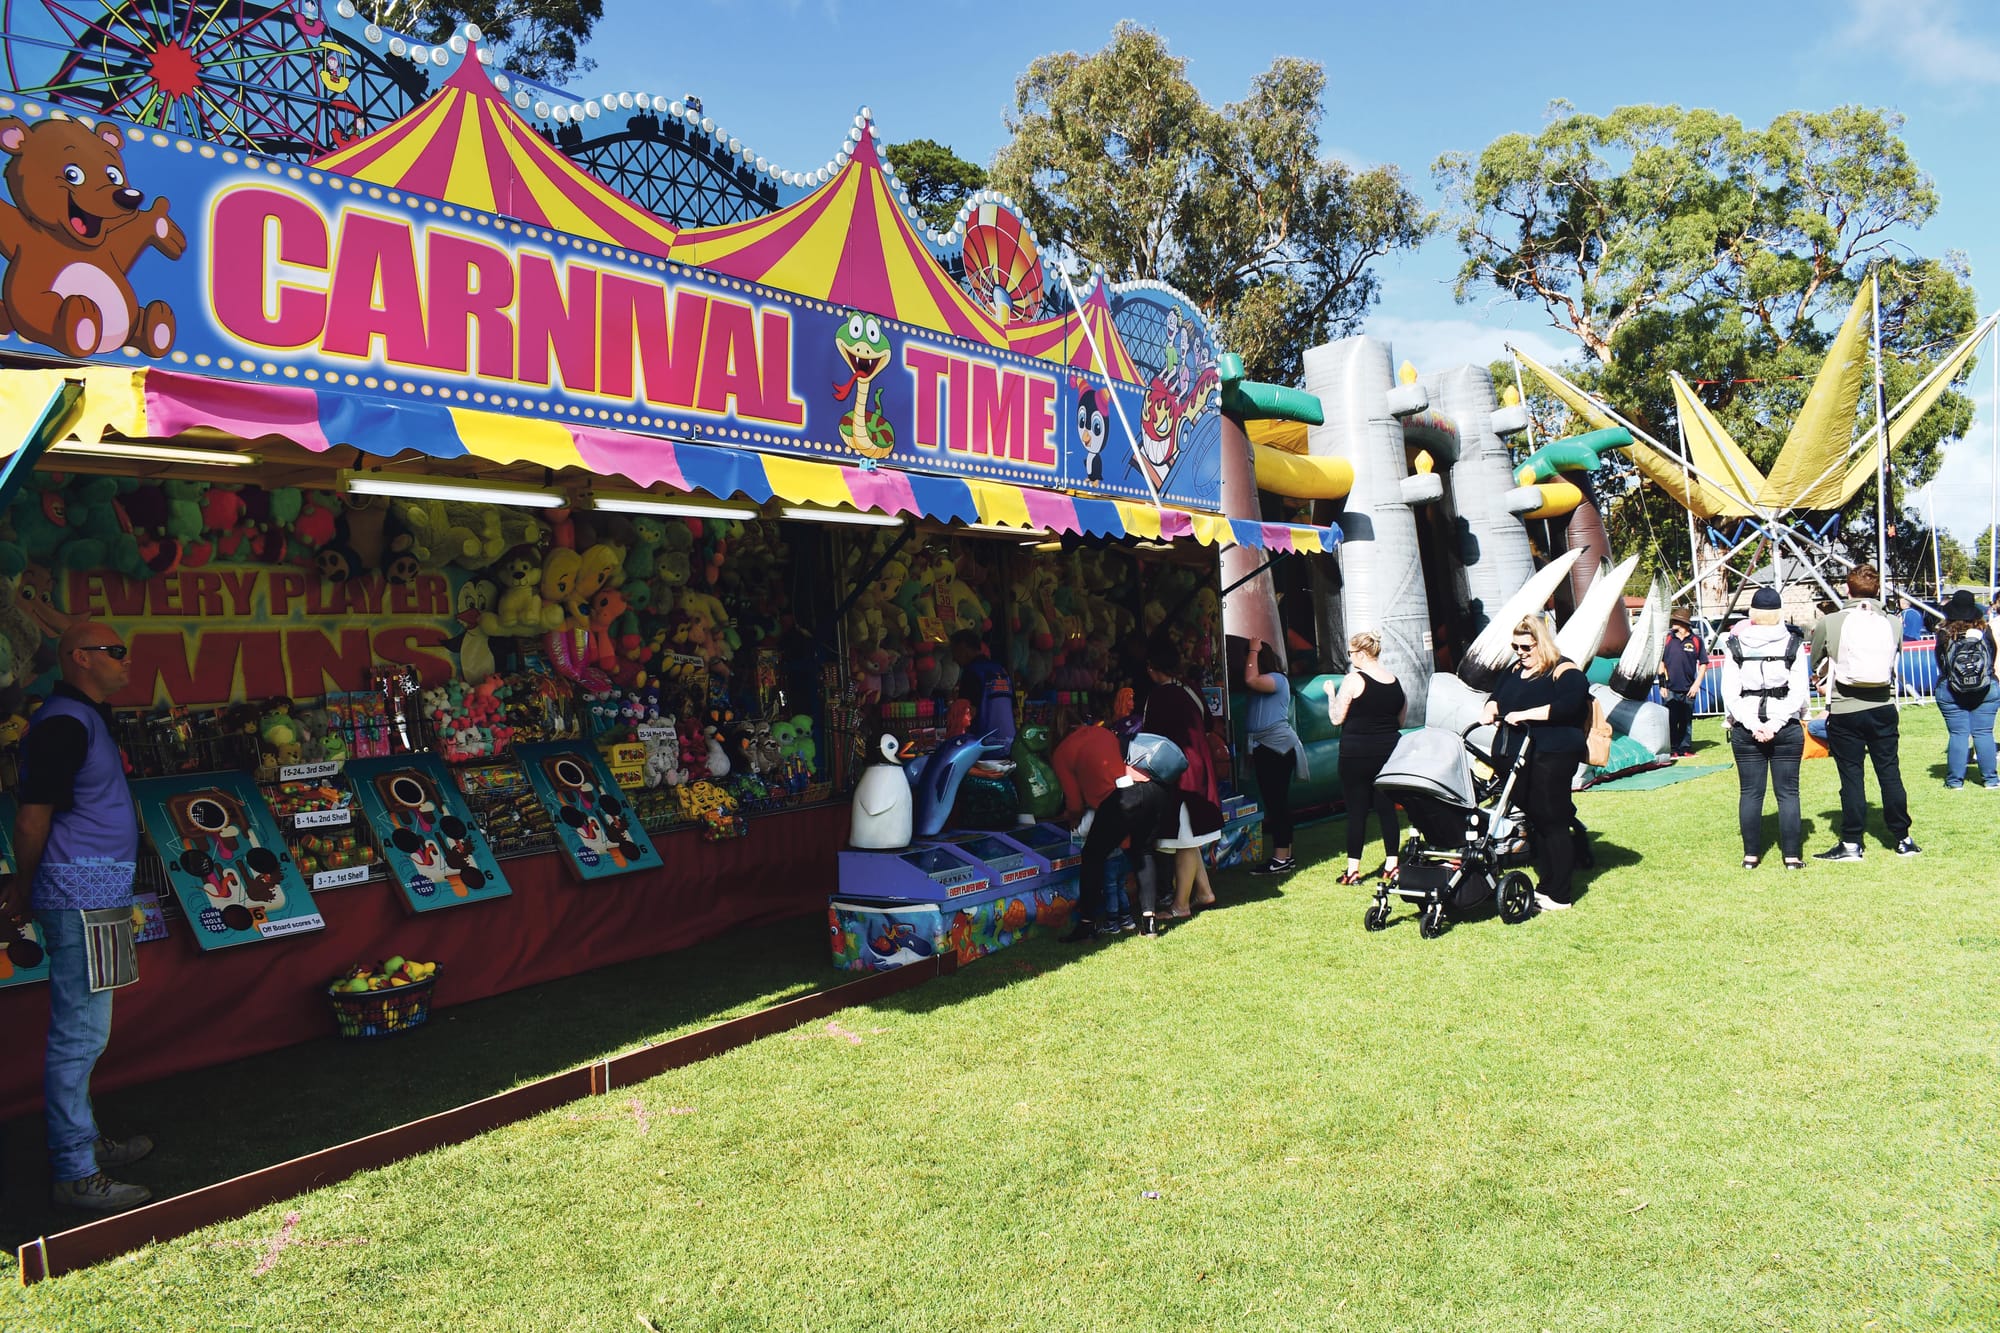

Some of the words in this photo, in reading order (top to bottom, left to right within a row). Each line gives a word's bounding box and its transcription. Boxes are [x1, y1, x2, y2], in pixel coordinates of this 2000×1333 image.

[212, 187, 805, 427] CARNIVAL
[904, 343, 1056, 468] TIME
[69, 570, 260, 617] EVERY
[267, 570, 450, 616] PLAYER
[1964, 676, 1977, 684] CAT
[318, 763, 336, 772] Shelf
[318, 814, 330, 822] 2nd
[332, 812, 348, 822] Shelf
[348, 870, 364, 880] Shelf
[484, 870, 494, 880] 6
[416, 886, 434, 894] TOSS
[200, 911, 221, 919] CORN
[206, 924, 227, 932] TOSS
[272, 923, 292, 931] Board
